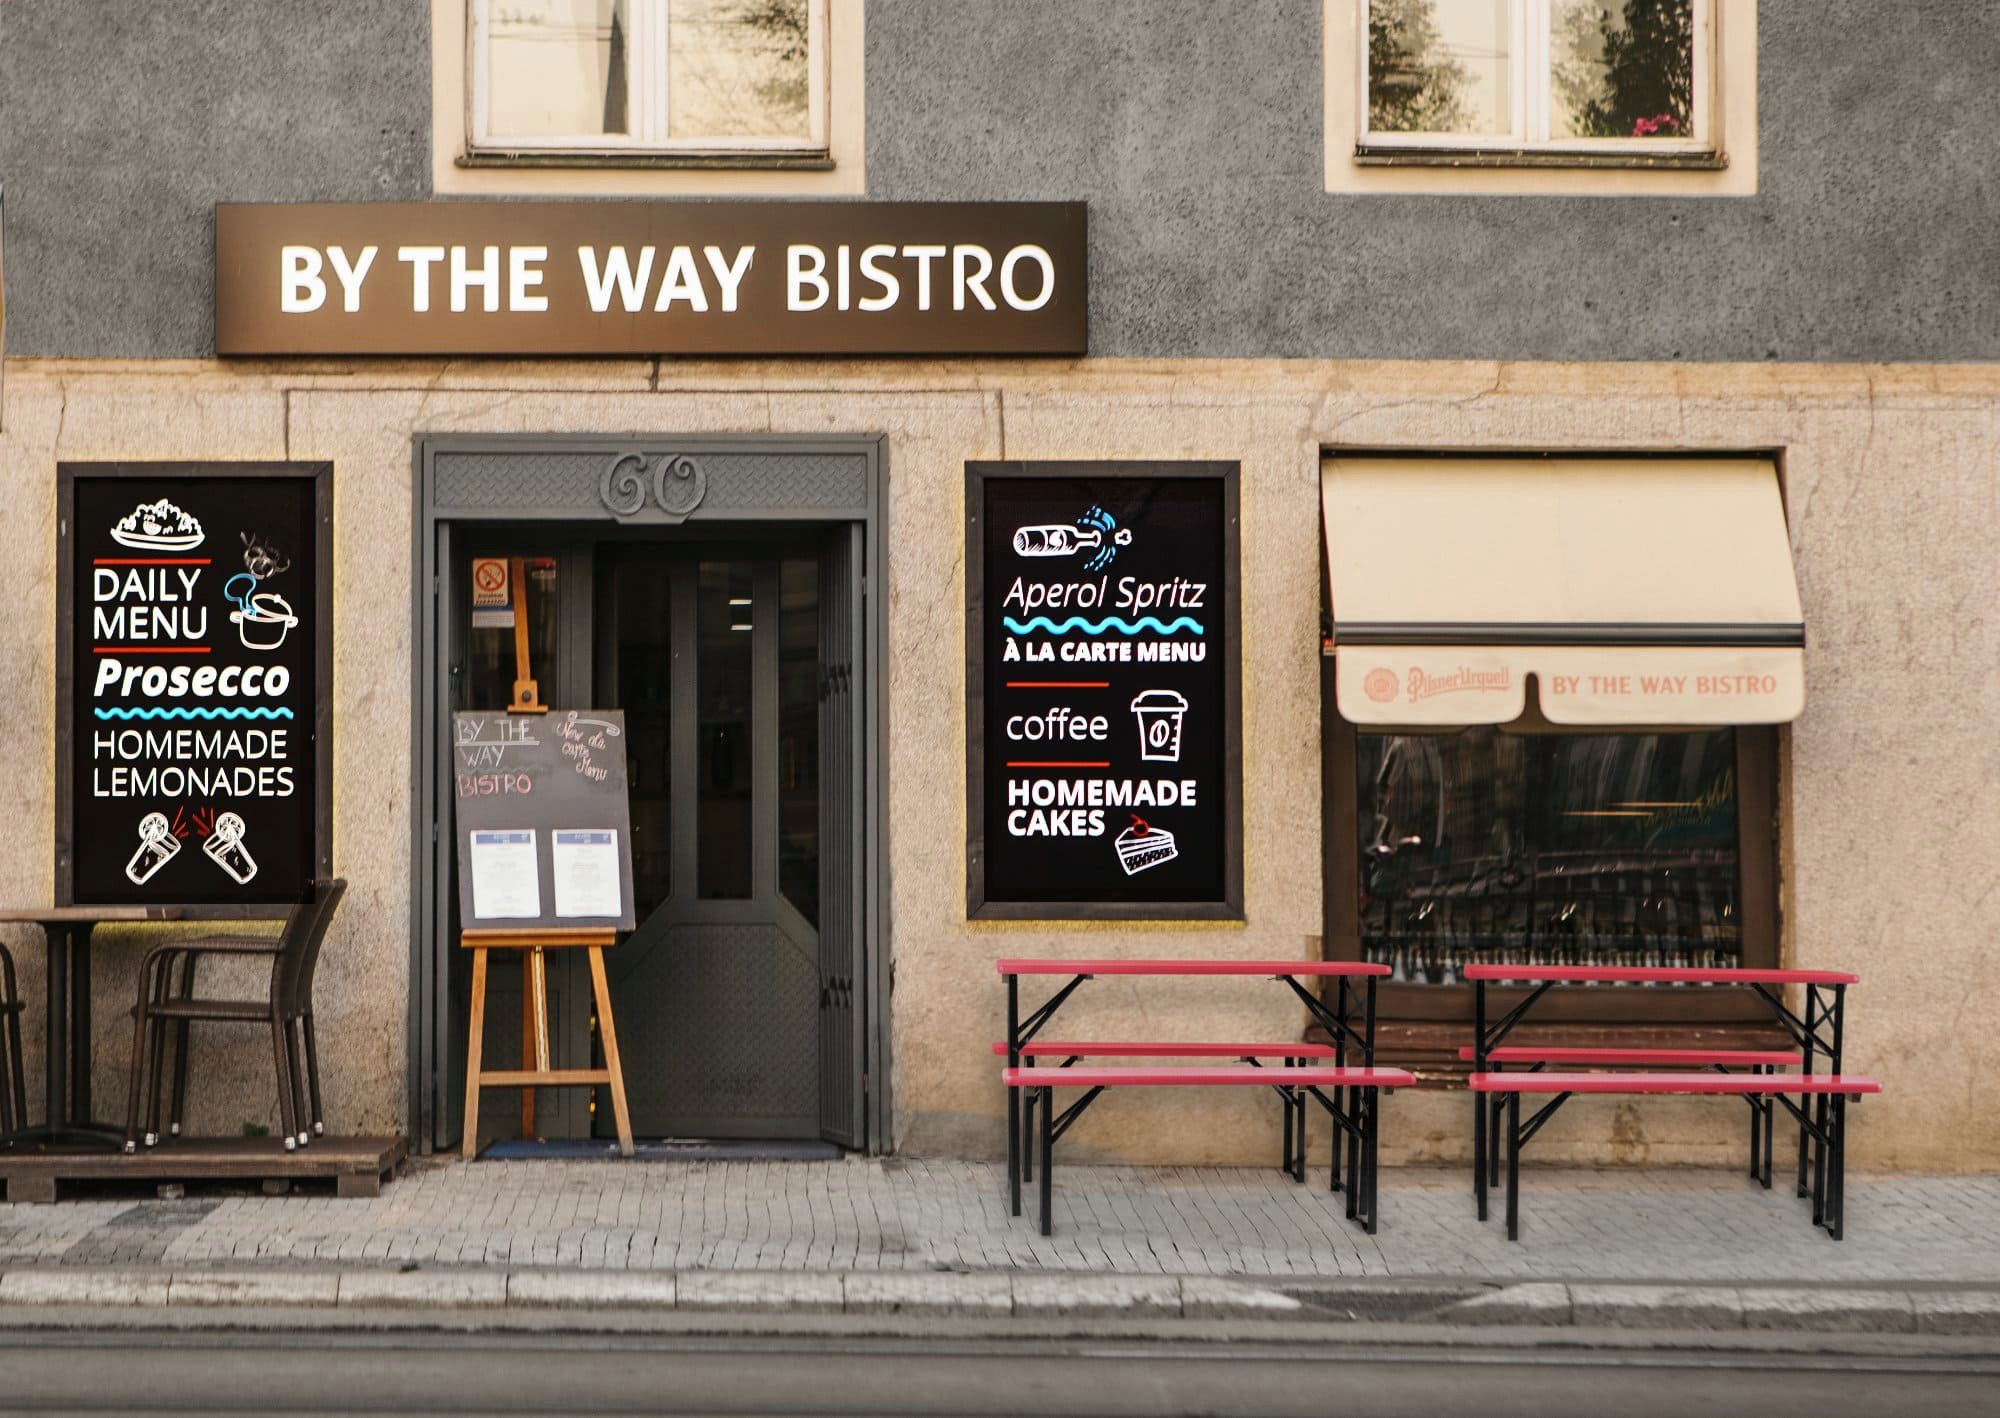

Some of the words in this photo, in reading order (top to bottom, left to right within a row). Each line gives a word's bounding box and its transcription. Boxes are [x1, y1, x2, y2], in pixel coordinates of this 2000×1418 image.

[280, 245, 378, 313] BY
[398, 245, 549, 313] THE
[578, 245, 755, 313] WAY
[786, 244, 1056, 312] BISTRO
[93, 568, 202, 602] DAILY
[1003, 575, 1108, 616] Aperol
[1115, 575, 1207, 616] Spritz
[93, 606, 207, 640] MENU
[1003, 636, 1021, 662] À
[1026, 641, 1056, 662] LA
[1060, 641, 1132, 662] CARTE
[1137, 641, 1206, 662] MENU
[93, 658, 290, 697] Prosecco
[1407, 666, 1460, 703] Pilsner
[1458, 666, 1509, 692] Urquell
[1552, 675, 1580, 694] BY
[1588, 676, 1631, 694] THE
[1640, 676, 1686, 694] WAY
[1694, 675, 1777, 694] BISTRO
[457, 719, 484, 742] BY
[500, 719, 535, 742] THE
[1006, 707, 1109, 741] coffee
[94, 729, 288, 760] HOMEMADE
[460, 745, 505, 768] WAY
[93, 766, 295, 797] LEMONADES
[458, 773, 532, 797] BISTRO
[1008, 779, 1197, 807] HOMEMADE
[1007, 809, 1106, 837] CAKES
